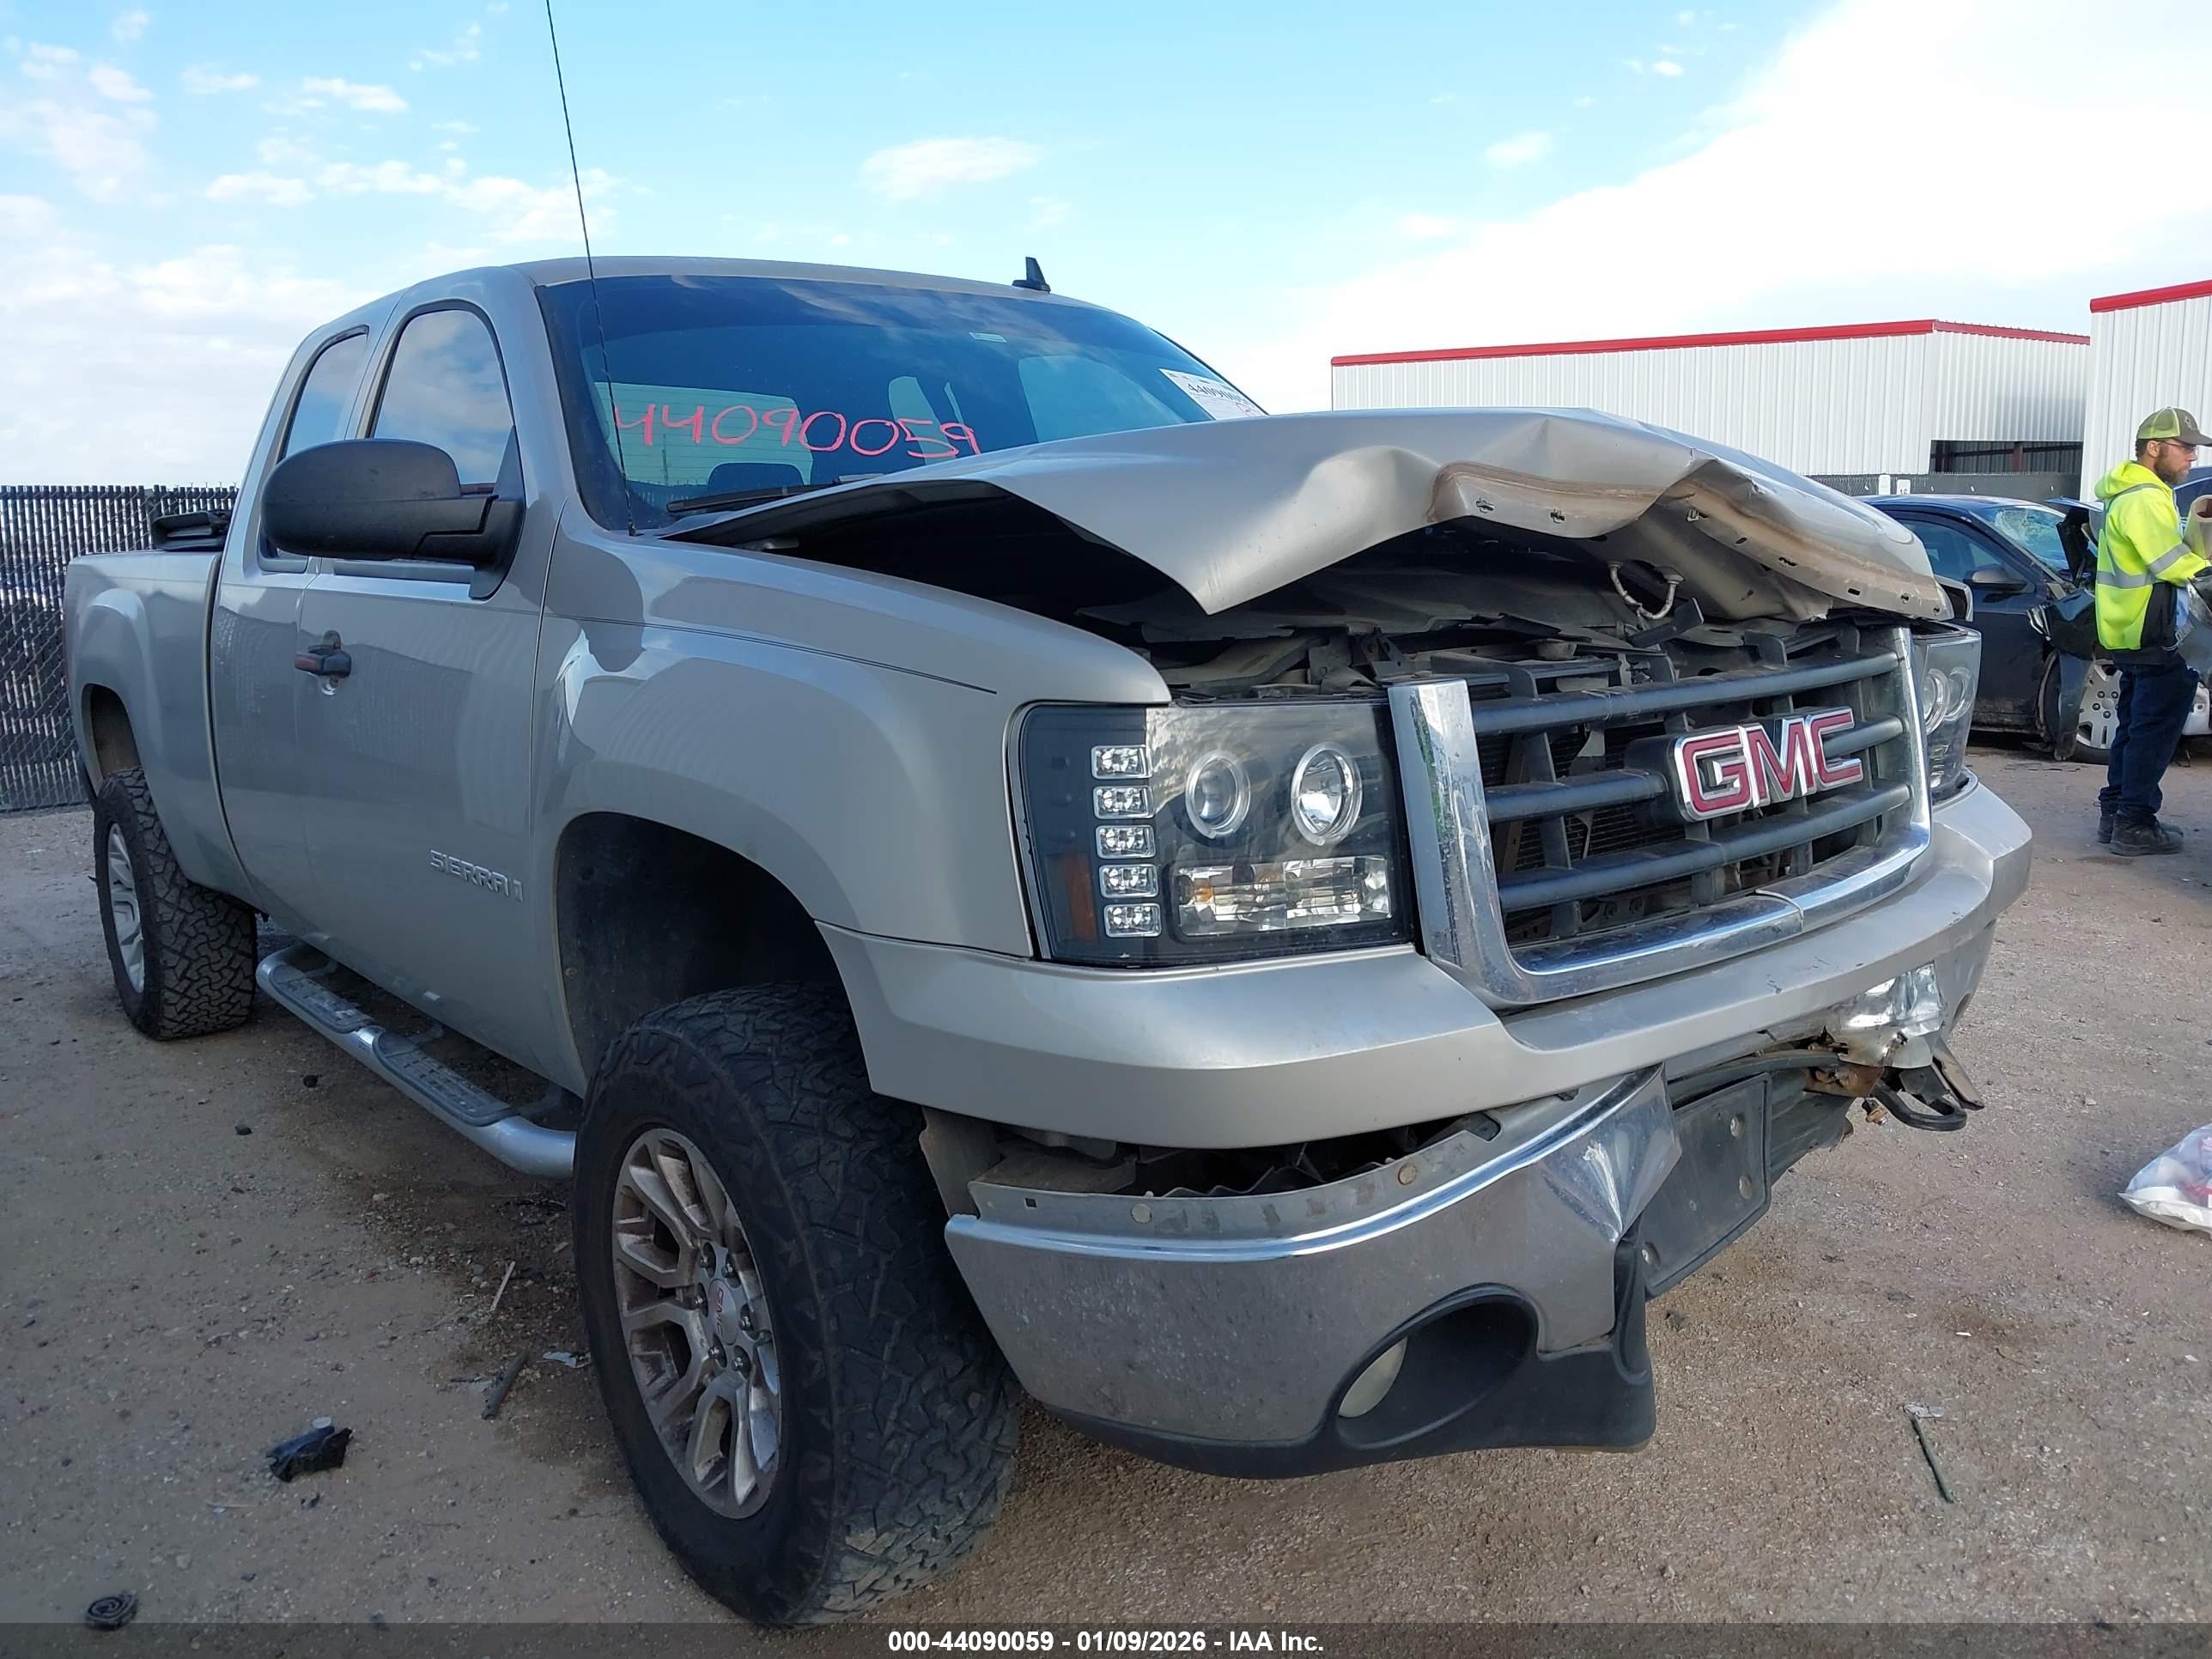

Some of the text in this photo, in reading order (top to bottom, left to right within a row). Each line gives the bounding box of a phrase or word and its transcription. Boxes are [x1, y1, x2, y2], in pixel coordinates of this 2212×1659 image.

[615, 404, 980, 459] 44090059
[1674, 706, 1863, 822] GMC
[430, 849, 509, 897] SIERRA
[715, 1287, 724, 1335] GMC
